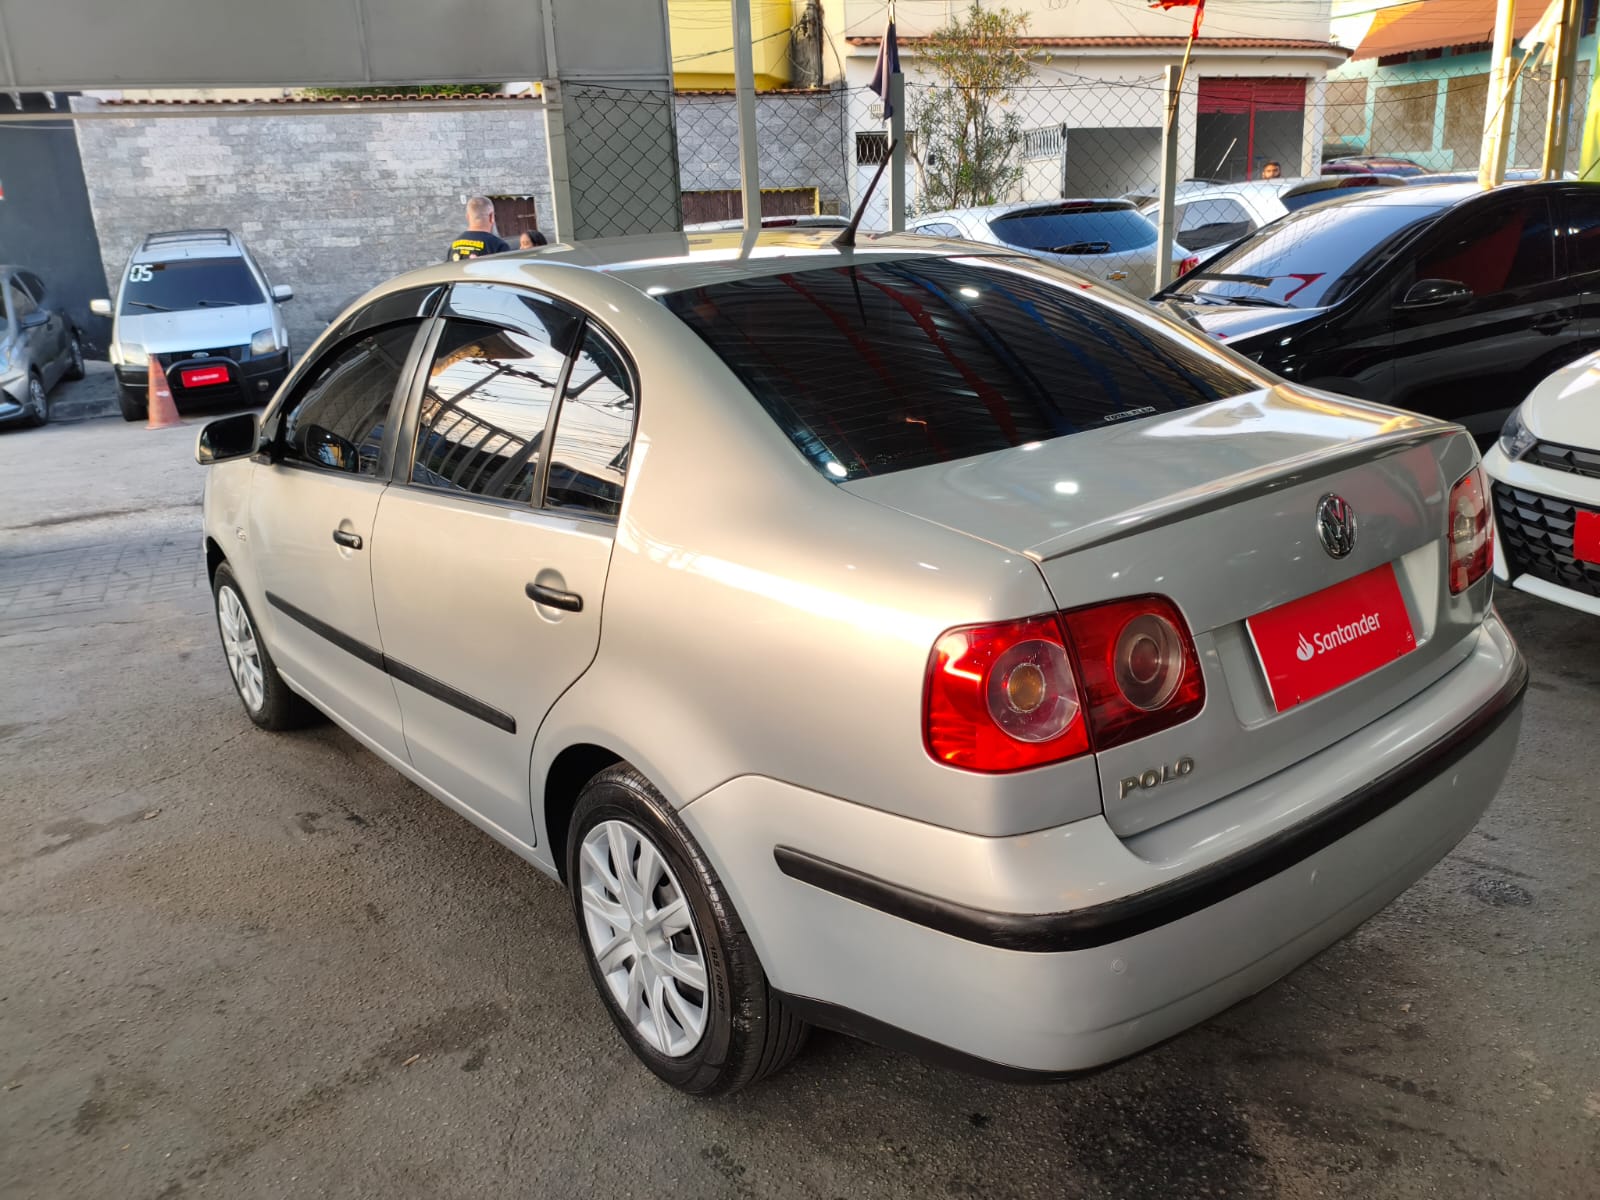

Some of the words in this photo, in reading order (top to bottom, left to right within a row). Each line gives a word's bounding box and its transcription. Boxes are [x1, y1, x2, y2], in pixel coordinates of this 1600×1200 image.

[130, 264, 153, 282] 05
[1313, 612, 1381, 654] Santander
[1119, 757, 1195, 800] POLO
